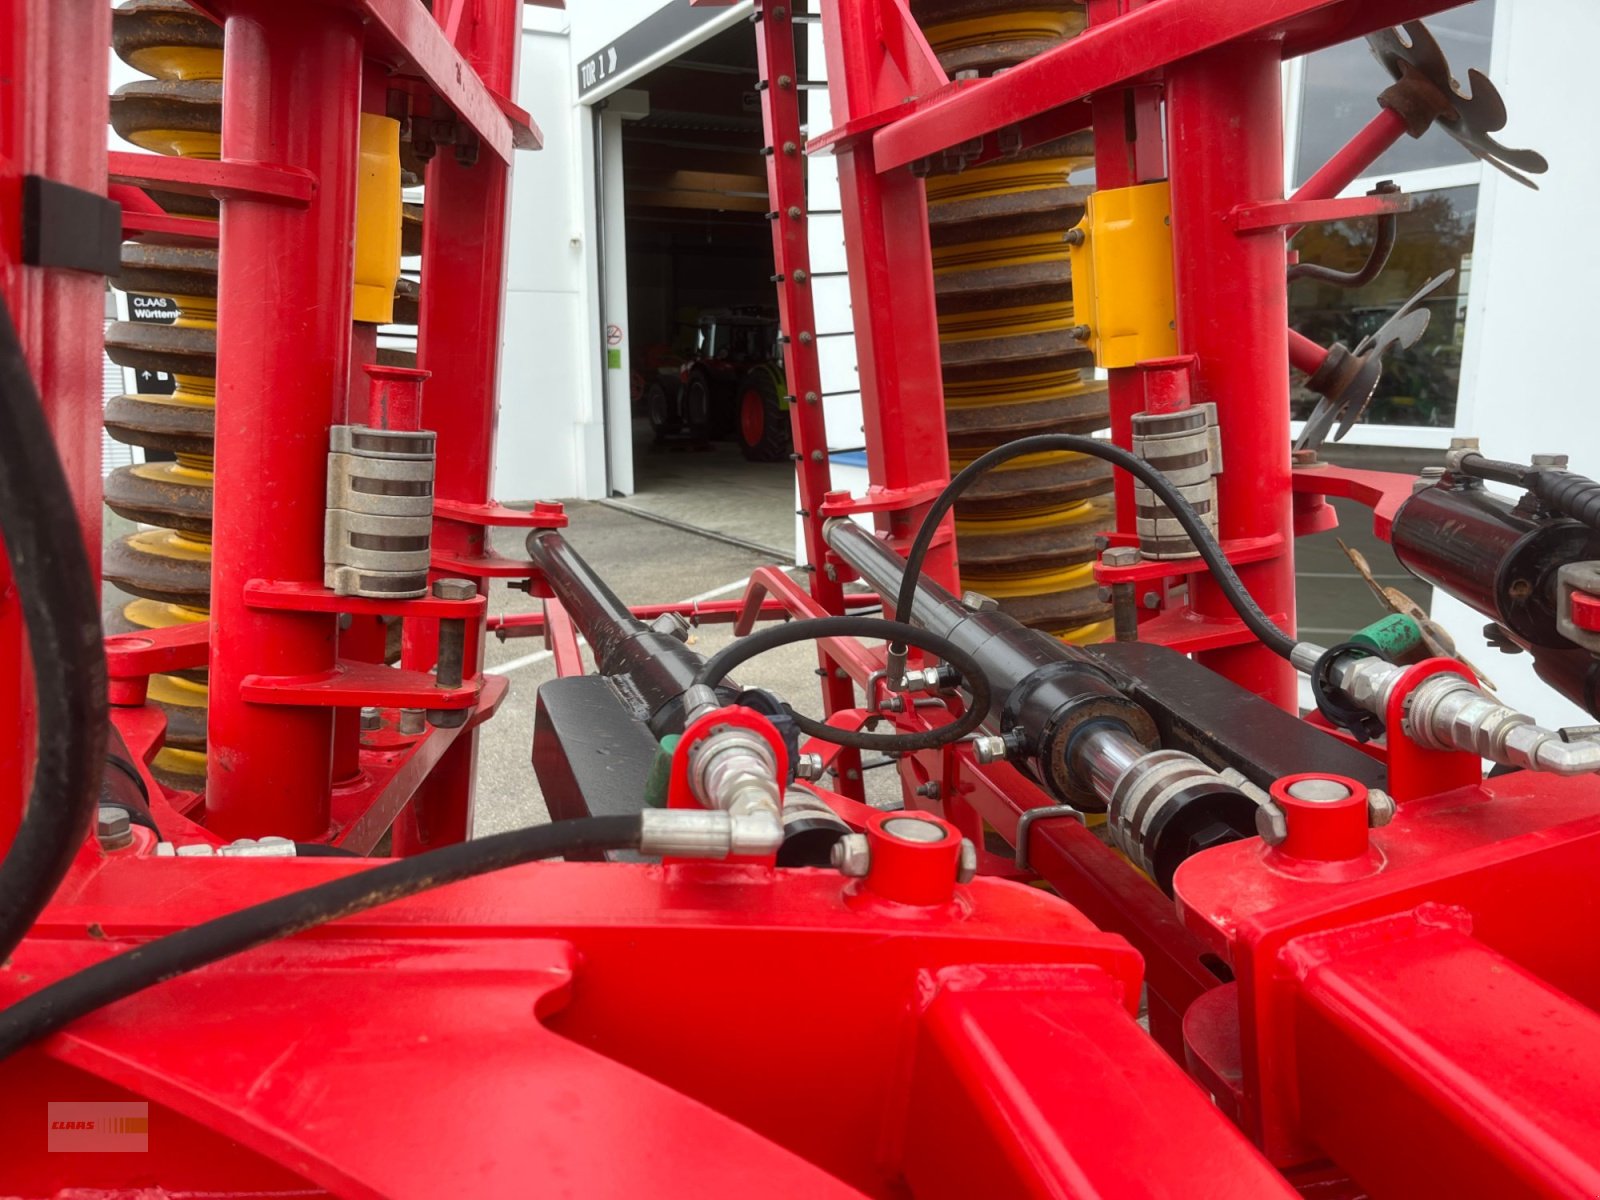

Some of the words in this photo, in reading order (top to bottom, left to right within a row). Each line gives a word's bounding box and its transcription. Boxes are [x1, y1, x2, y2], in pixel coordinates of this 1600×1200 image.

[581, 60, 596, 89] TOR
[598, 54, 605, 80] 1
[134, 298, 167, 307] CLAAS
